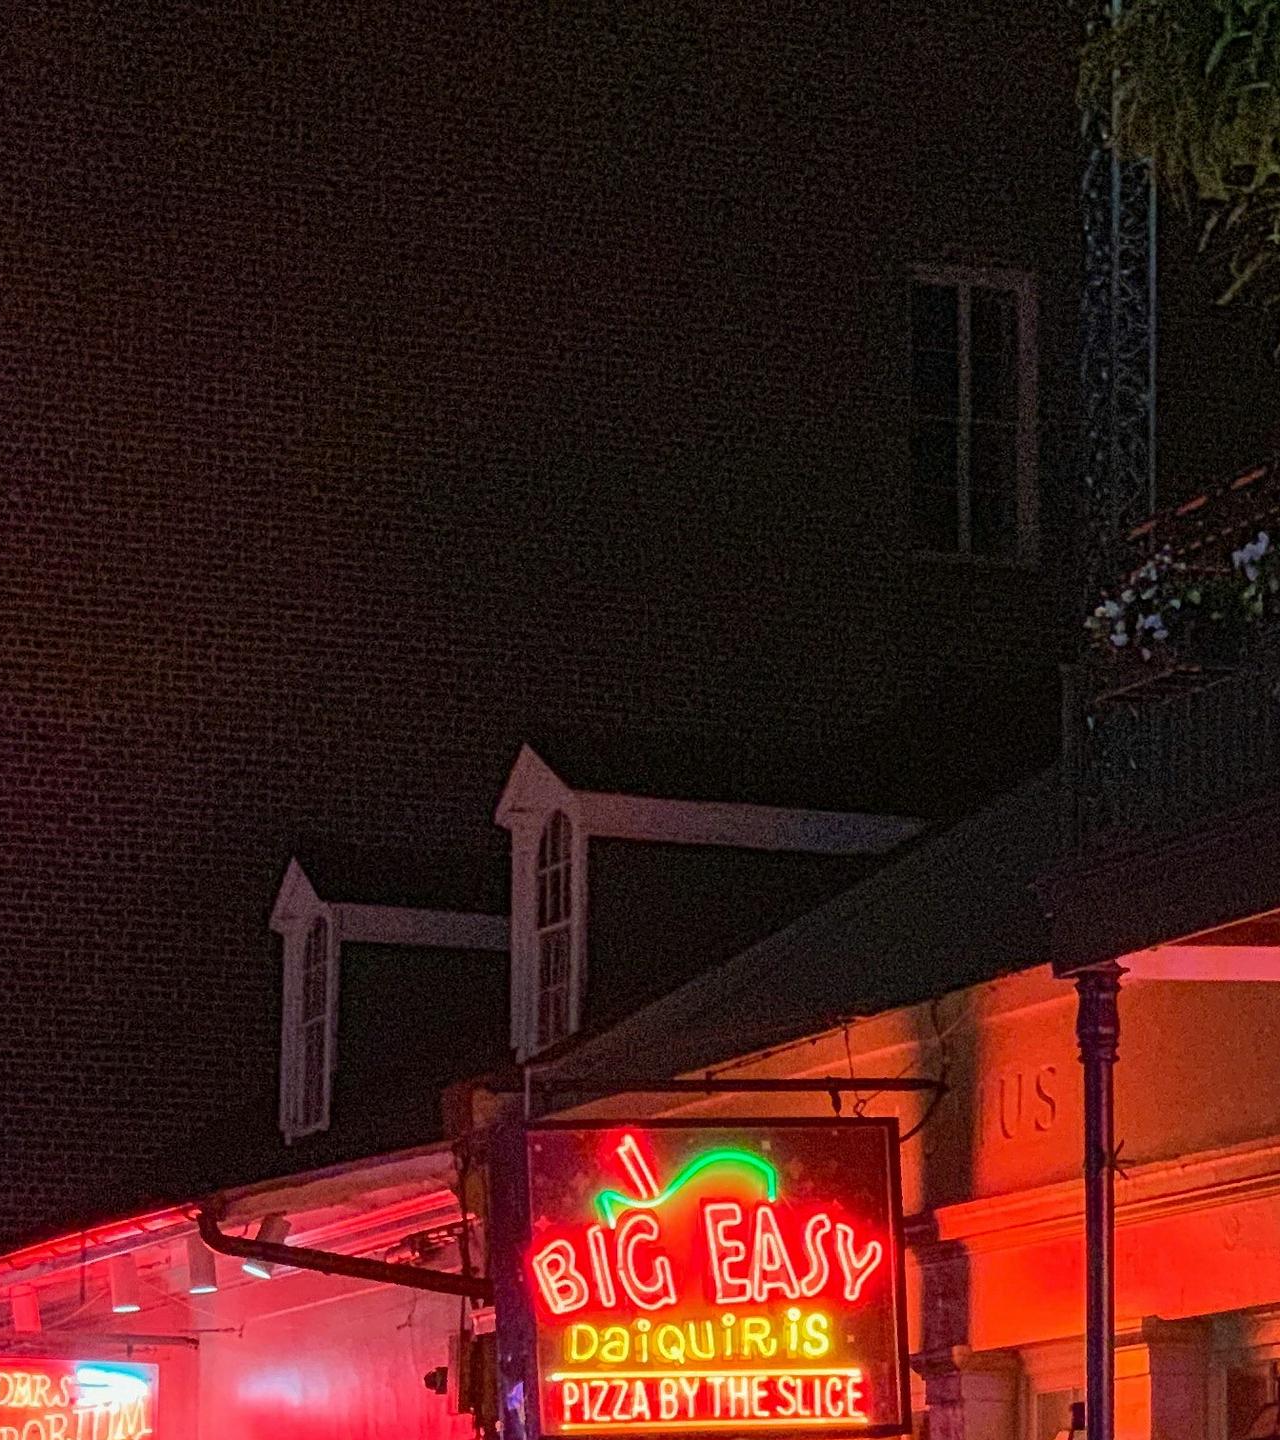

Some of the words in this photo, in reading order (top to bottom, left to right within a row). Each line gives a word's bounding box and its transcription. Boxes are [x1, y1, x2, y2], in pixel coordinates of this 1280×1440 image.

[532, 1213, 678, 1315] BIG
[704, 1202, 883, 1304] EASY
[562, 1378, 652, 1422] PIZZA
[659, 1376, 701, 1419] BY
[705, 1375, 771, 1419] THE
[775, 1374, 867, 1418] SLICE
